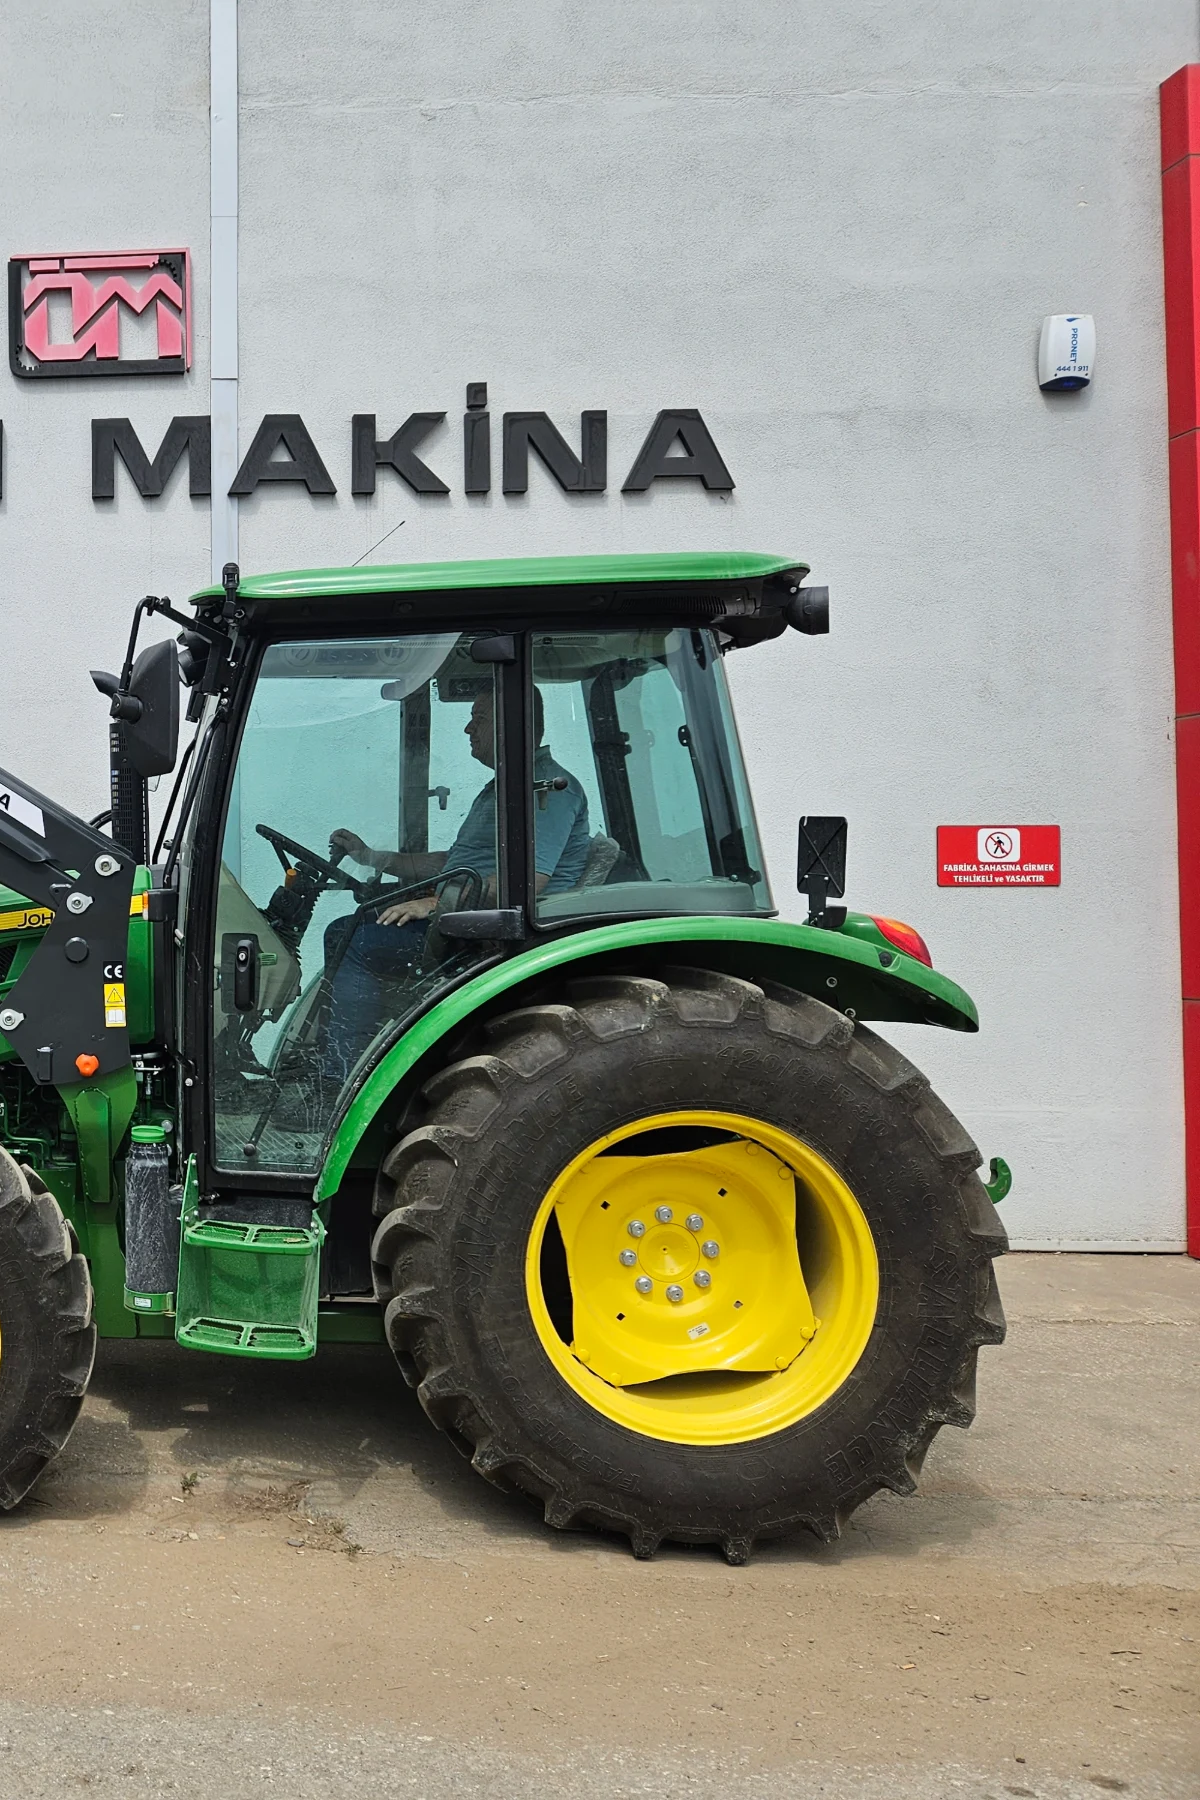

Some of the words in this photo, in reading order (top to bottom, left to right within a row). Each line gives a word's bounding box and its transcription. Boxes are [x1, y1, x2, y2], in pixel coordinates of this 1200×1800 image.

[1069, 327, 1079, 364] PRONET
[91, 381, 736, 499] MAKİNA
[943, 863, 978, 872] FABRİKA
[979, 863, 1021, 872] SAHASINA
[1022, 862, 1055, 872] GİRMEK
[953, 874, 994, 883] TEHLİKELİ
[1004, 874, 1045, 883] YASAKTIR
[17, 912, 54, 928] JOH
[103, 964, 123, 979] CE
